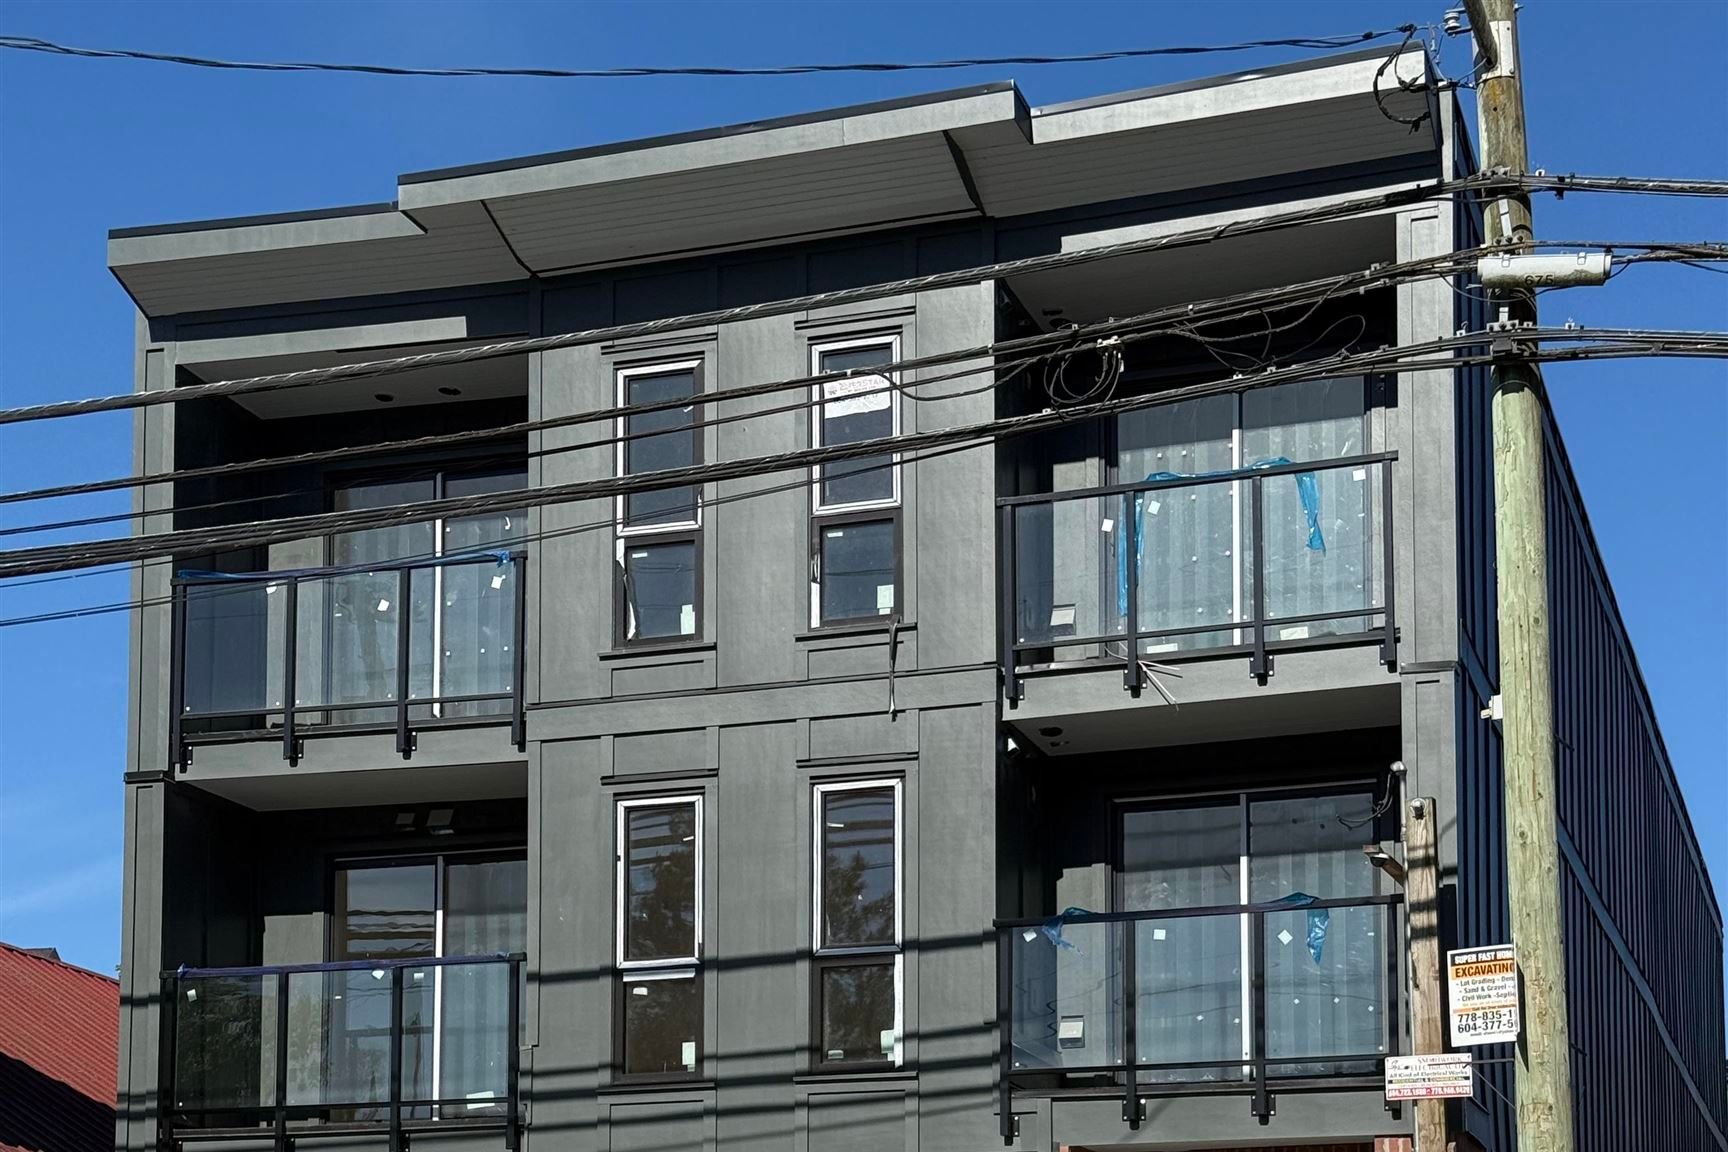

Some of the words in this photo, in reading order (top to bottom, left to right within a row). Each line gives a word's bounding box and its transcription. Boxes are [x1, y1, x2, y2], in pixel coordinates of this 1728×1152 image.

[1524, 274, 1554, 285] 675
[1454, 953, 1477, 964] SUPER
[1478, 952, 1495, 961] FAST
[1472, 978, 1495, 986] Grading
[1458, 1010, 1517, 1023] 778-835-1
[1458, 1019, 1518, 1034] 604-377-5
